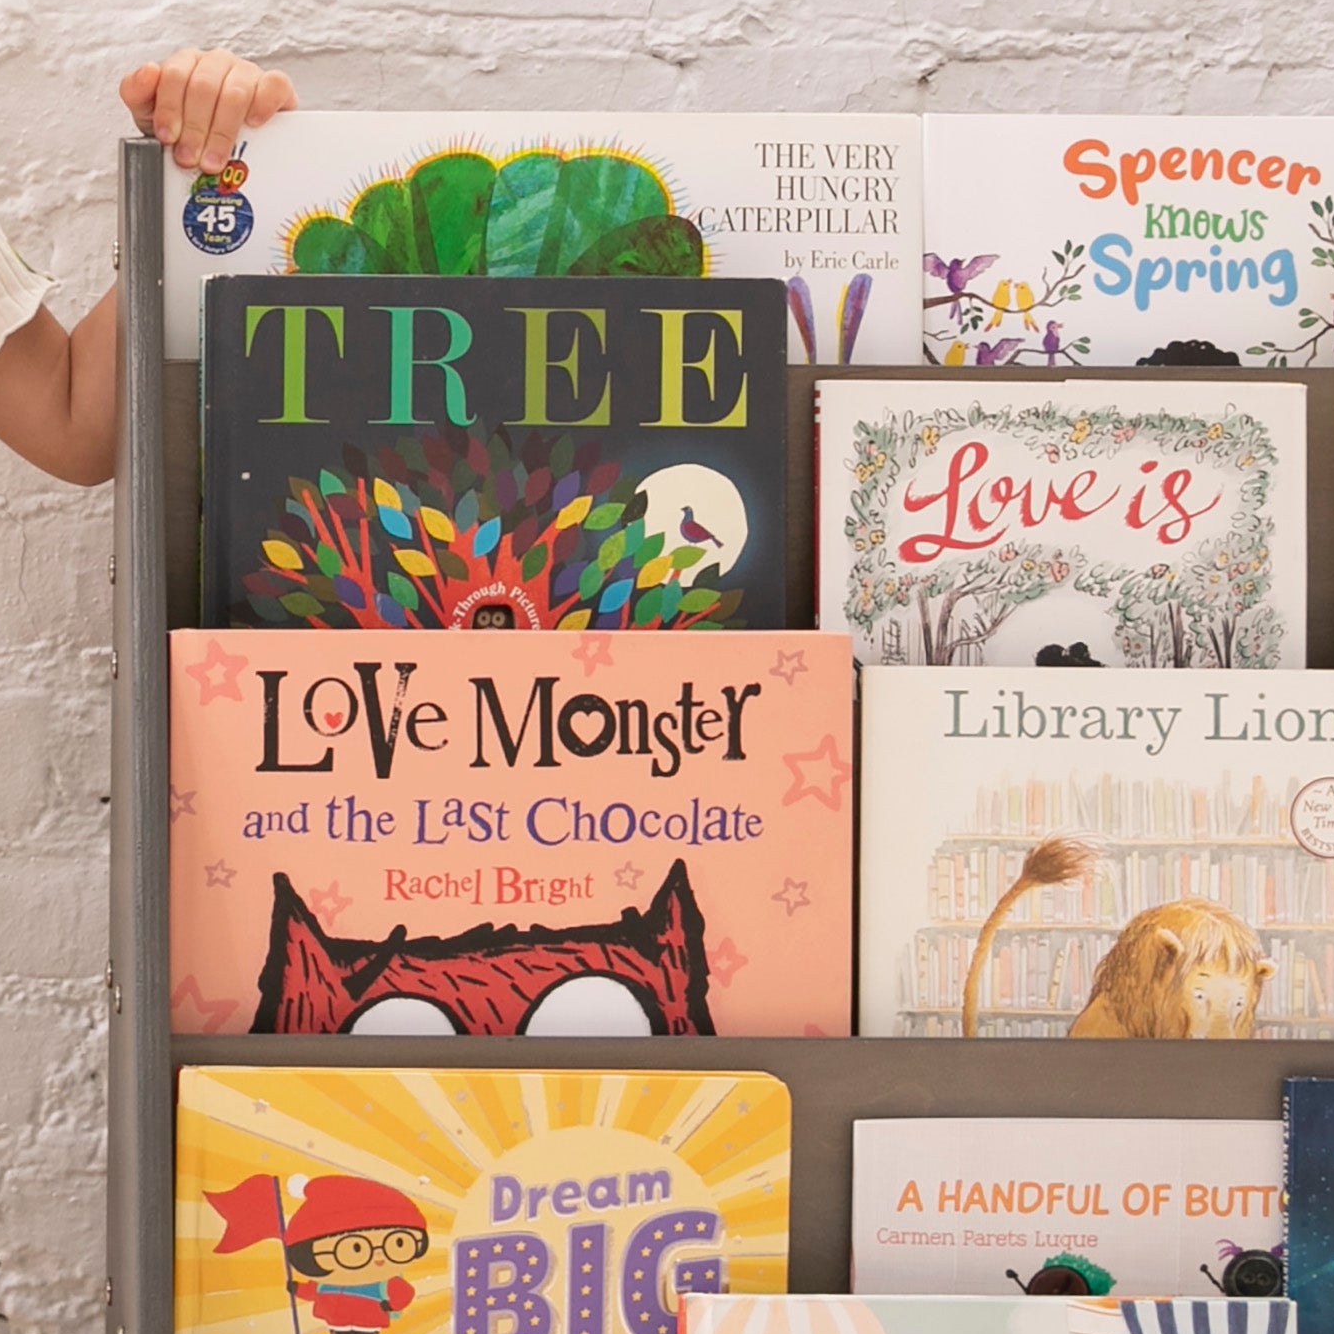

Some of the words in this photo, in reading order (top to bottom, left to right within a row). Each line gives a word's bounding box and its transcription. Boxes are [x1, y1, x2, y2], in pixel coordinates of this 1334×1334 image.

[754, 143, 815, 168] THE
[824, 144, 899, 170] VERY
[1063, 138, 1321, 205] Spencer
[775, 175, 899, 202] HUNGRY
[197, 205, 236, 233] 45
[698, 206, 900, 234] CATERPILLAR
[784, 250, 806, 274] by
[811, 250, 847, 269] Eric
[852, 251, 899, 270] Carle
[1089, 233, 1298, 311] Spring
[246, 306, 748, 428] TREE
[897, 441, 1121, 564] Love
[1123, 460, 1223, 545] is
[943, 690, 1182, 756] Library
[243, 802, 309, 838] and
[325, 795, 396, 842] the
[1303, 800, 1331, 812] New
[384, 867, 482, 904] Rachel
[493, 865, 595, 905] Bright
[491, 1170, 672, 1224] Dream
[896, 1180, 924, 1213] A
[938, 1180, 1108, 1215] HANDFUL
[1122, 1183, 1172, 1216] OF
[1184, 1183, 1285, 1217] BUTT
[876, 1227, 956, 1247] Carmen
[963, 1229, 1027, 1247] Parets
[1034, 1229, 1099, 1250] Luque
